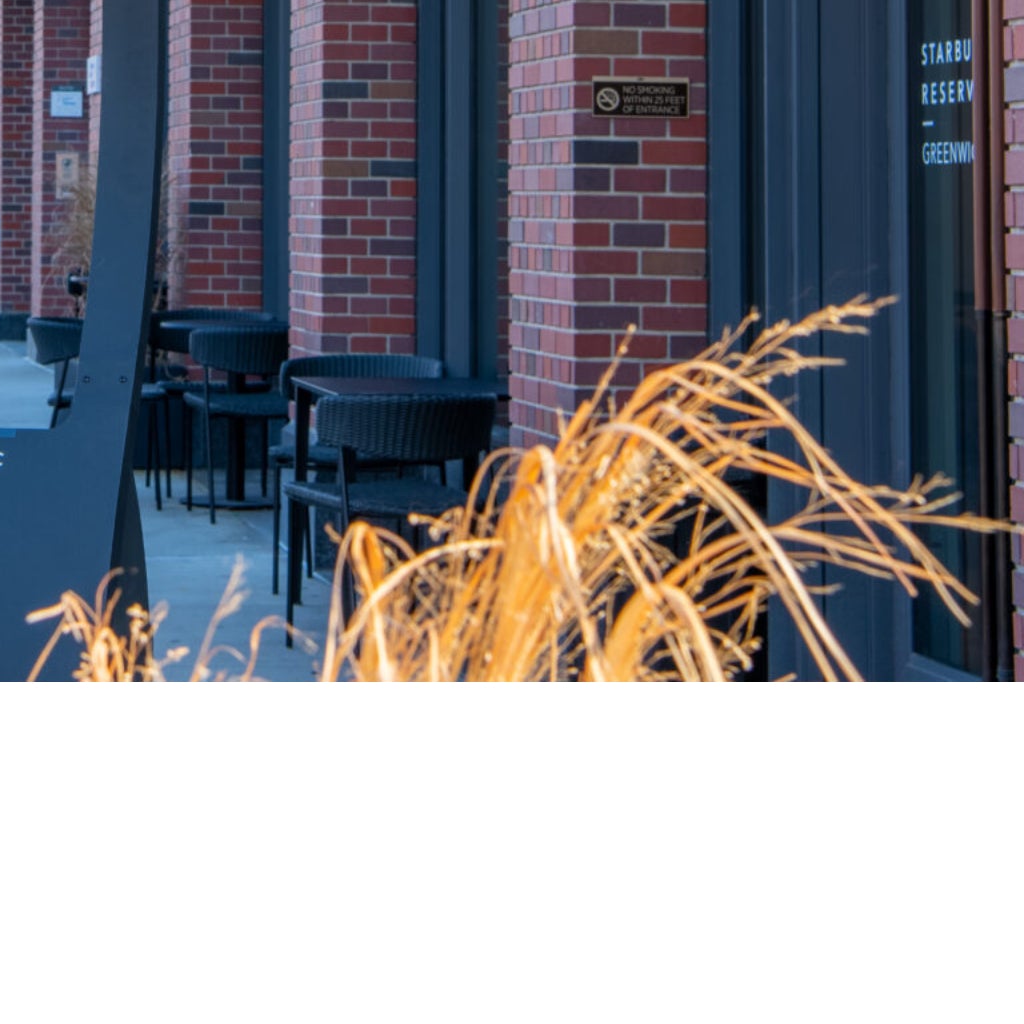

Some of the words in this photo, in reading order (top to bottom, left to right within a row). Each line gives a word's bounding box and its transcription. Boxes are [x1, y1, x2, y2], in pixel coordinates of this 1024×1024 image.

[921, 38, 972, 66] STARBU
[622, 85, 636, 94] NO
[637, 85, 676, 95] SMOKING
[623, 96, 653, 104] WITHIN
[665, 96, 685, 104] FEET
[622, 105, 635, 114] OF
[636, 105, 681, 114] ENTRANCE
